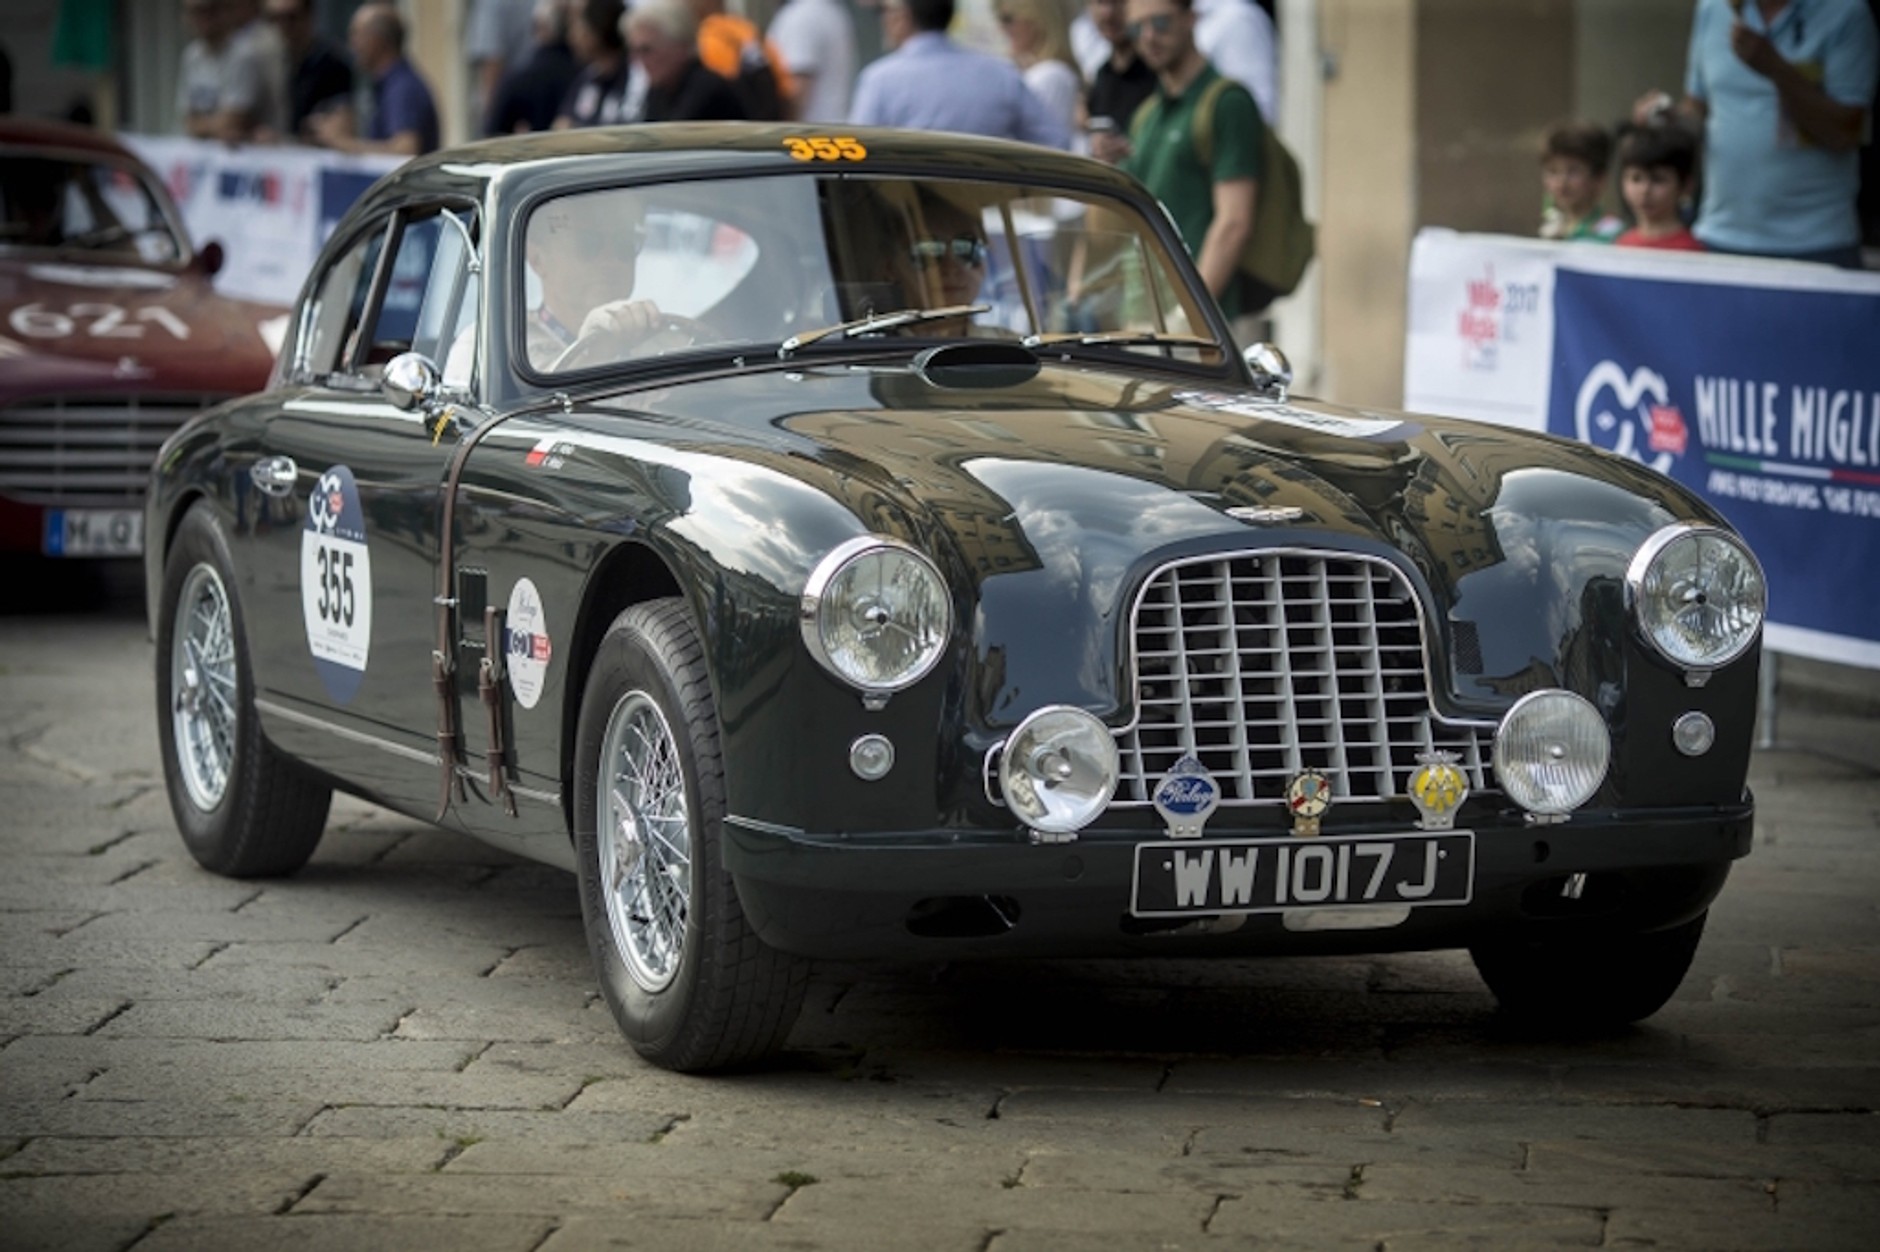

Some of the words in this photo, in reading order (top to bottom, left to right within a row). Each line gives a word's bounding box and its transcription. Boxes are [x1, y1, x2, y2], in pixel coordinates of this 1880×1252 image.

[782, 136, 867, 162] 355
[8, 302, 191, 340] 621
[1694, 374, 1779, 457] MILLE
[317, 545, 354, 628] 355
[1174, 847, 1259, 907] WW
